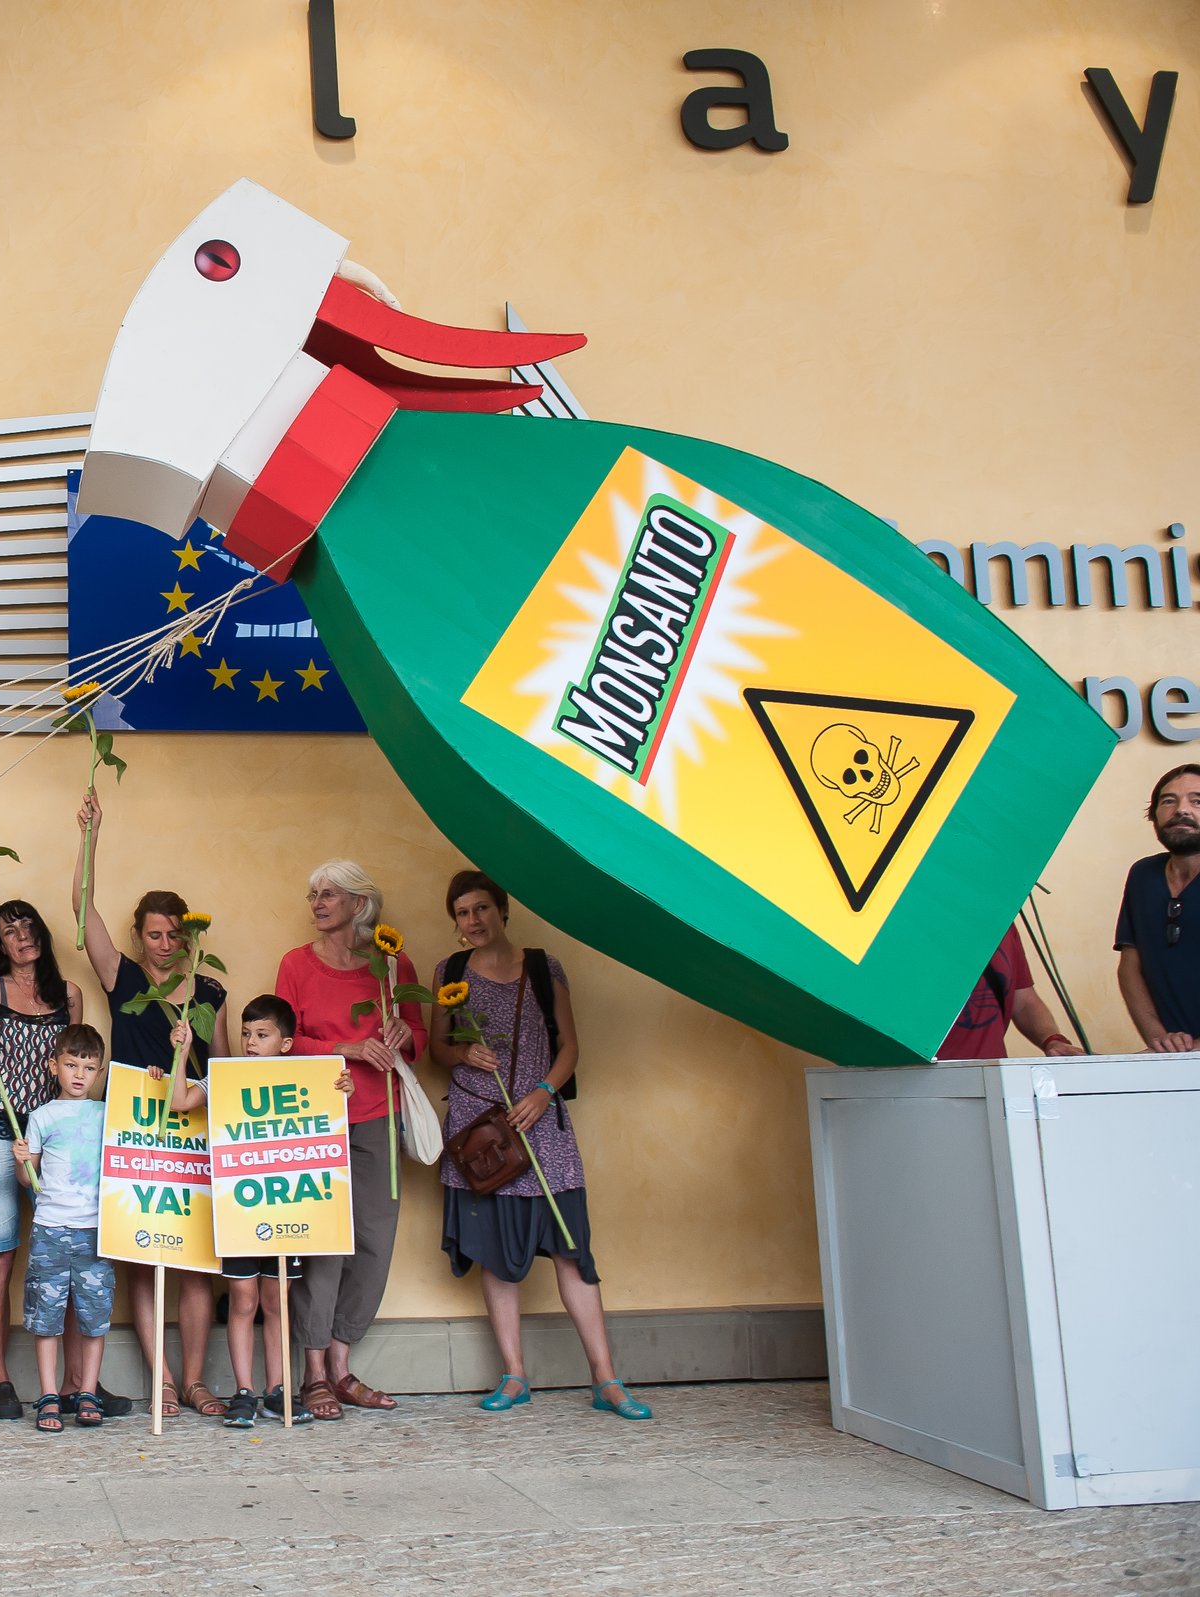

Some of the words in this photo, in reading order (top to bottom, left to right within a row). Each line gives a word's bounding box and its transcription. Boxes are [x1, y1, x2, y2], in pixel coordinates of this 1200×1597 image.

[880, 517, 1200, 608] mmi
[558, 505, 716, 774] MONSANTO
[241, 1084, 310, 1117] UE:
[225, 1115, 330, 1141] VIETATE
[110, 1155, 130, 1169] EL
[130, 1157, 211, 1176] GLIFOSATO
[221, 1153, 239, 1168] IL
[240, 1143, 343, 1166] GLIFOSATO
[132, 1184, 191, 1216] YA!
[234, 1171, 333, 1207] ORA!
[153, 1233, 184, 1246] STOP
[275, 1223, 309, 1234] STOP
